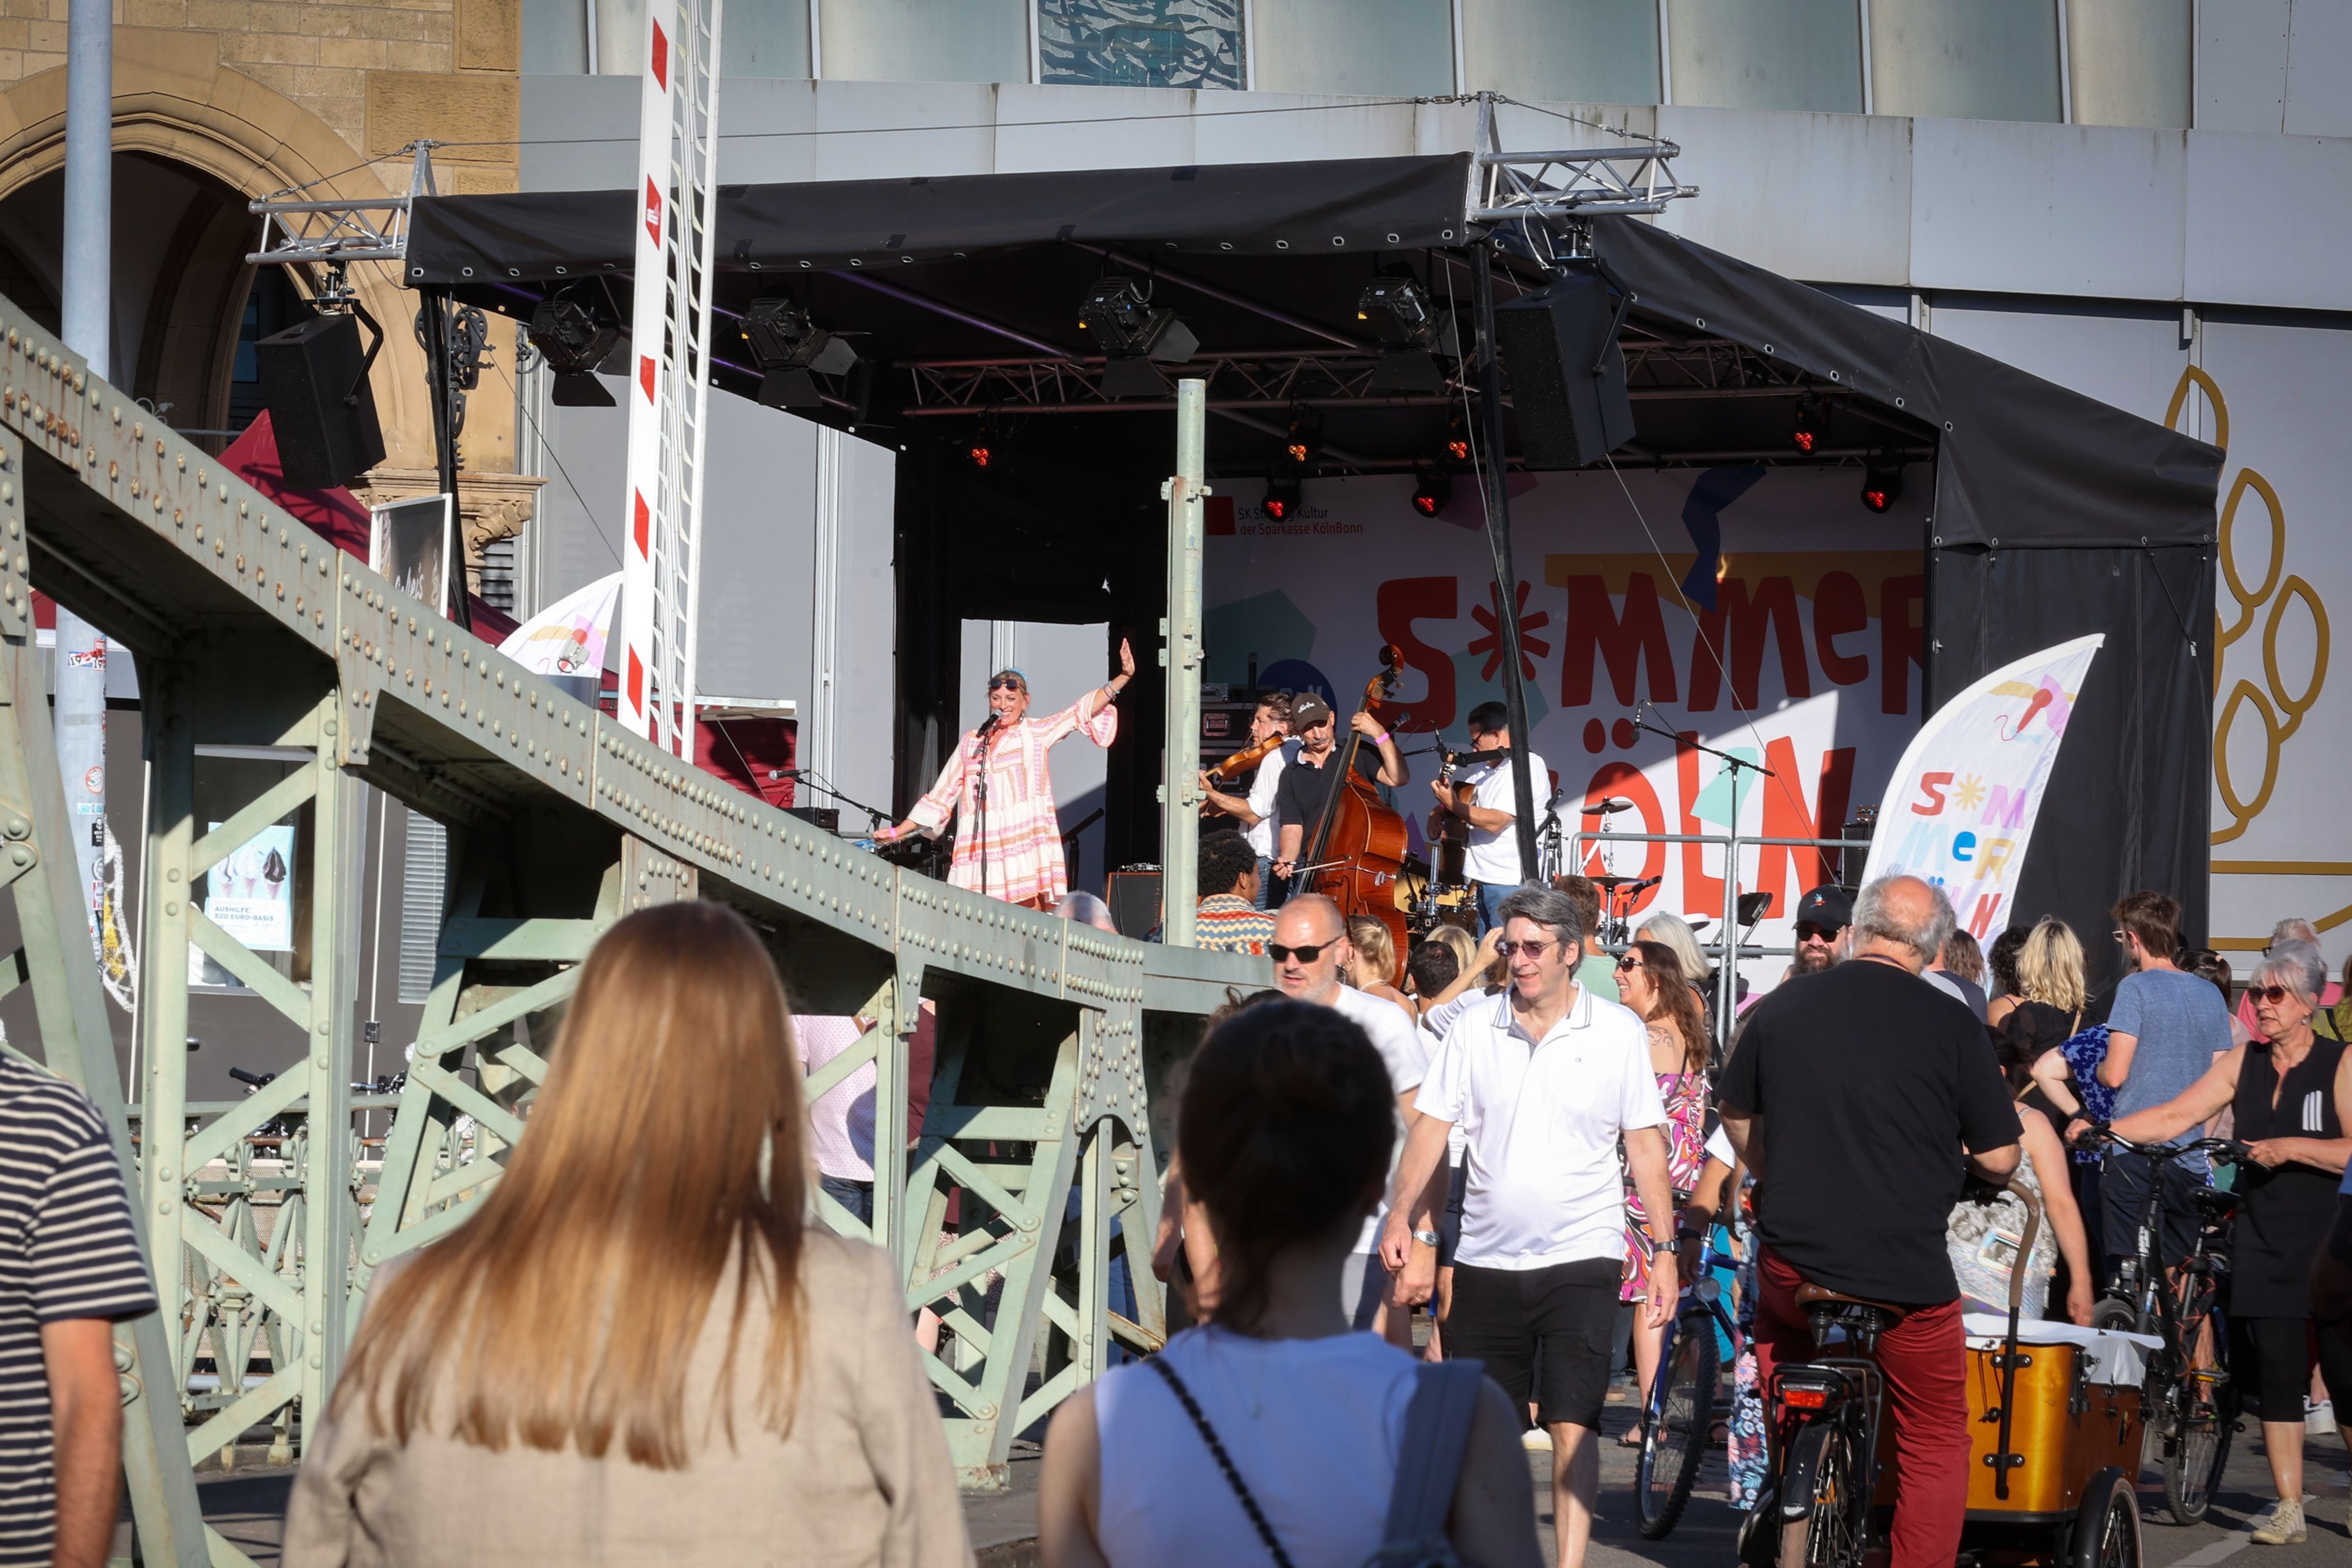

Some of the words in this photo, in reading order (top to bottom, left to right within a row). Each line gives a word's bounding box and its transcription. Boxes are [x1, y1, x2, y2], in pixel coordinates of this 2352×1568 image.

[1238, 508, 1251, 520] SK
[1298, 507, 1328, 519] Kultur
[1240, 523, 1255, 535] der
[1259, 523, 1310, 537] Sparkasse
[1313, 522, 1363, 534] KölnBonn
[1548, 717, 1856, 918] ÖLN
[230, 914, 274, 922] EURO-BASIS
